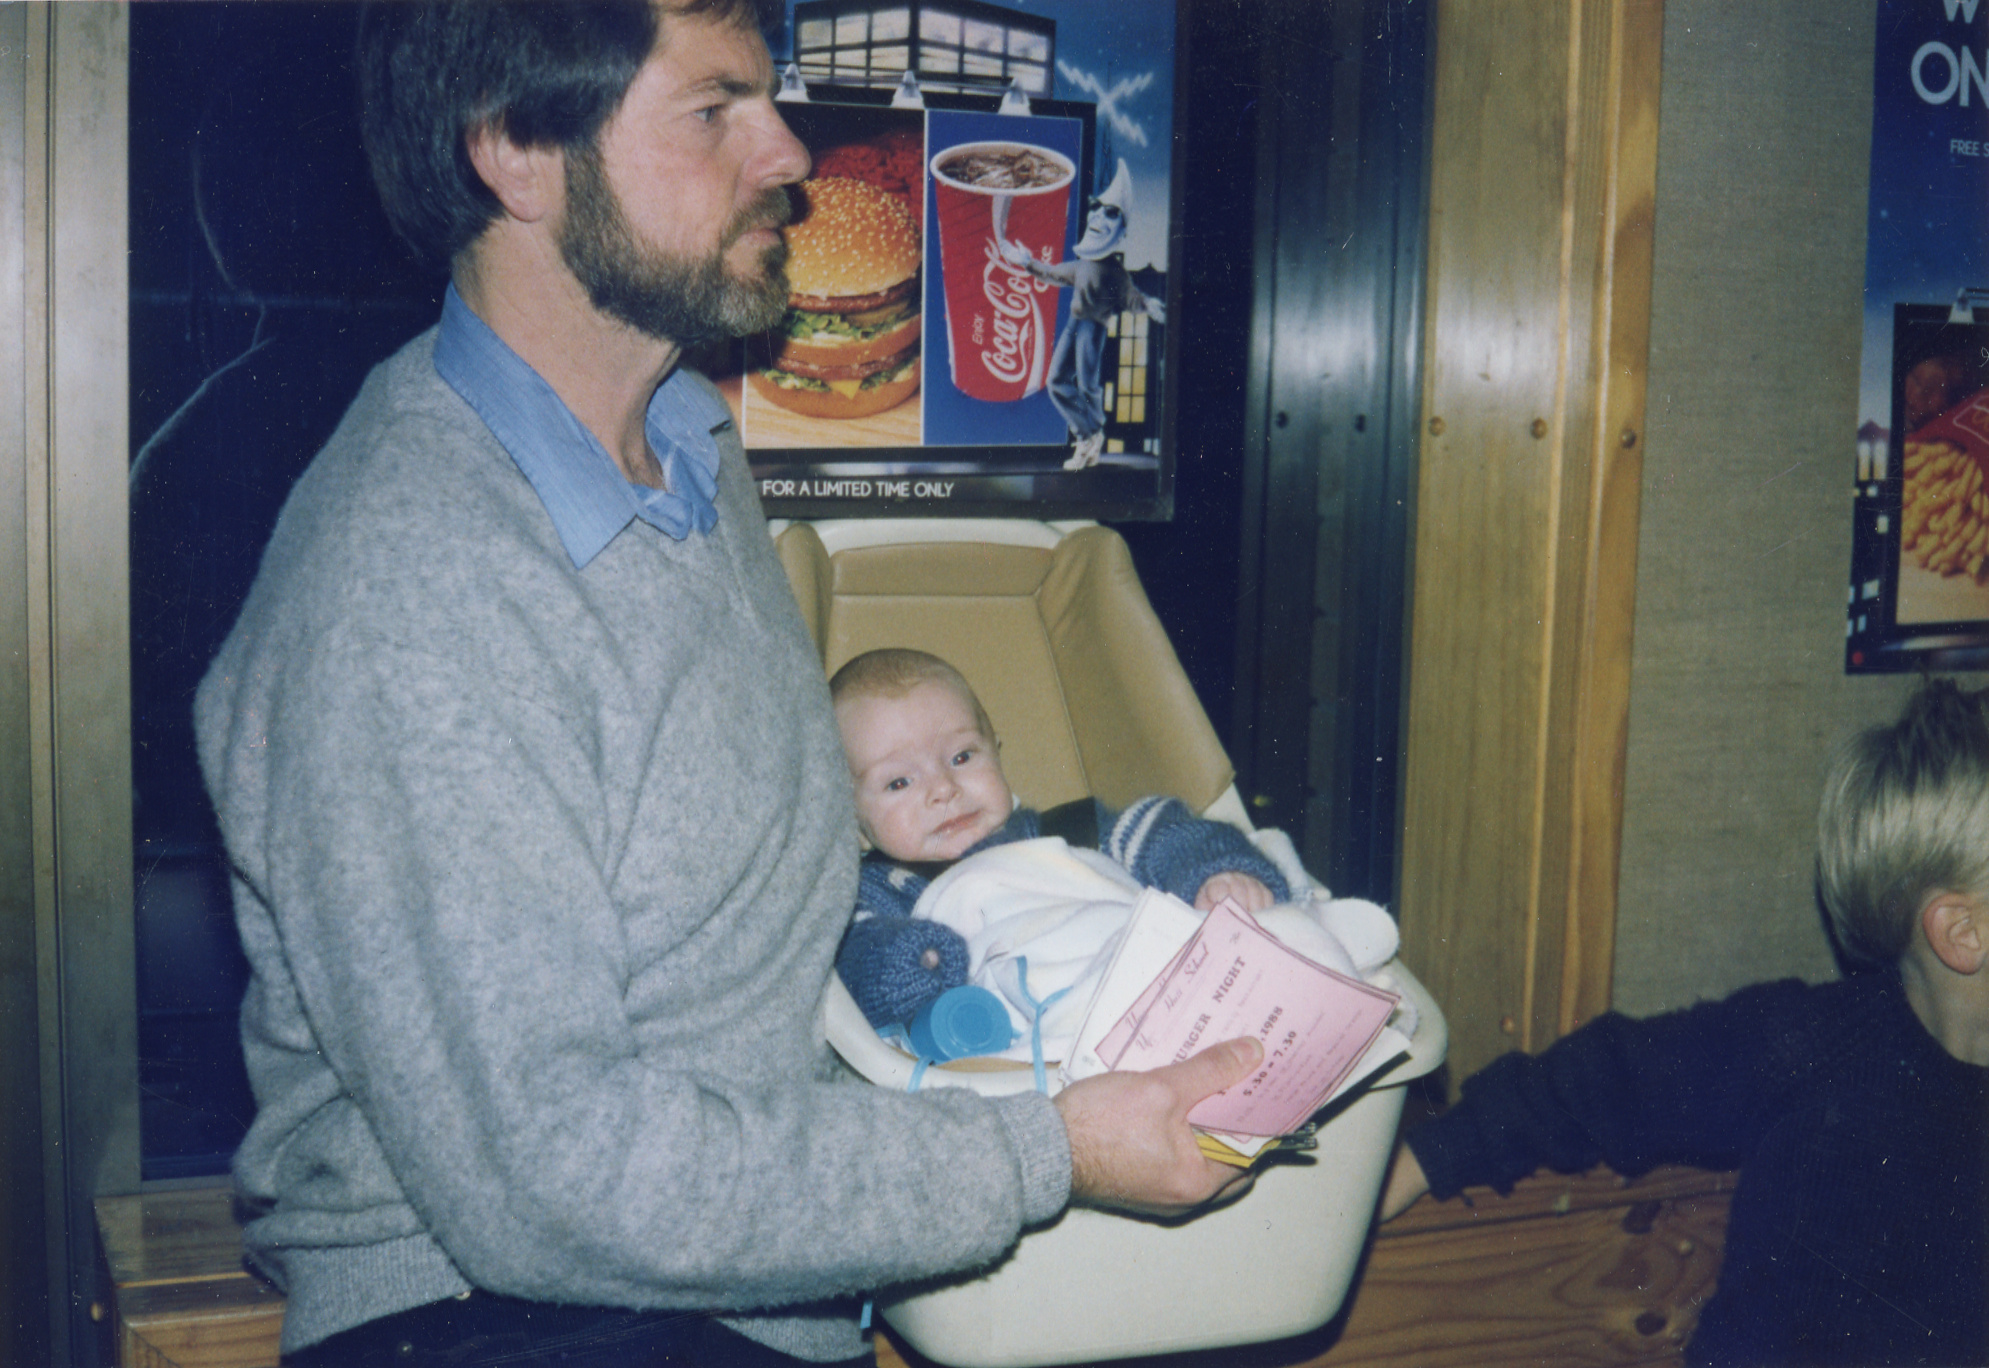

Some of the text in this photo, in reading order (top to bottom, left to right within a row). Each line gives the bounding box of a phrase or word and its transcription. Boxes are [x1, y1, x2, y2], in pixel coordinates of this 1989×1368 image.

[1950, 138, 1980, 156] FREE
[972, 313, 985, 346] Enjoy
[762, 480, 955, 498] FOR A LIMITED TIME ONLY
[1211, 955, 1246, 1003] NIGHT
[1243, 1071, 1268, 1097] 5.30
[1273, 1030, 1297, 1057] 7.30
